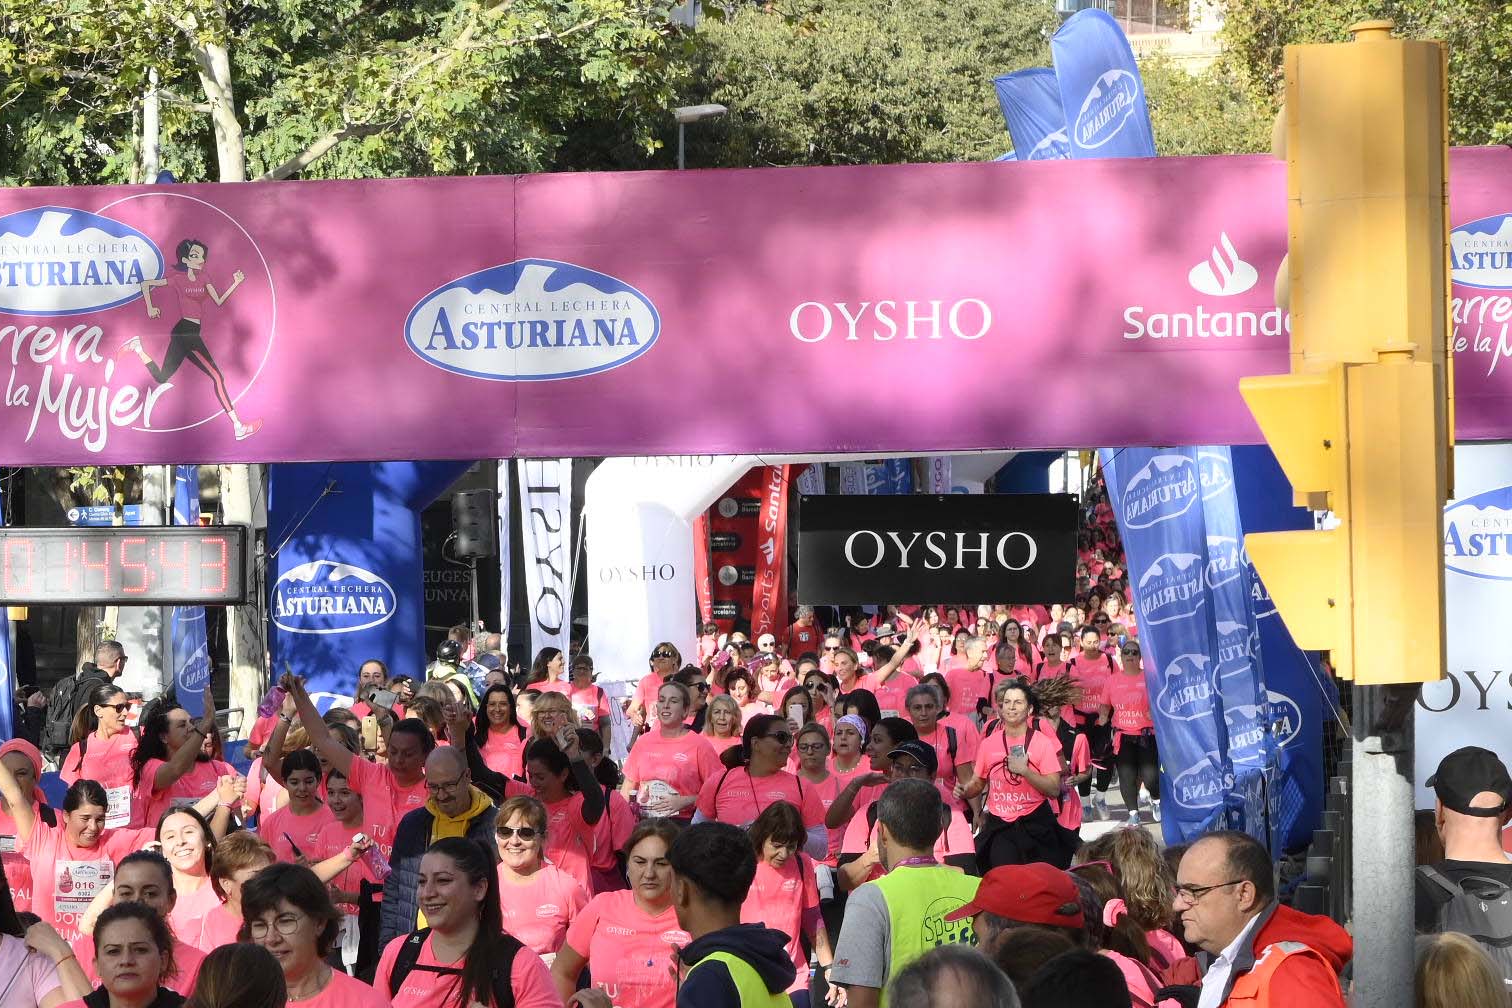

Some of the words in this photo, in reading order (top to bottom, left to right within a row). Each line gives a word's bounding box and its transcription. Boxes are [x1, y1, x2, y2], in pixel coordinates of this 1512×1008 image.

[65, 243, 139, 254] LECHERA
[1464, 239, 1512, 248] CENTRA
[464, 301, 542, 314] CENTRAL
[550, 300, 632, 313] LECHERA
[425, 306, 640, 351] ASTURIANA
[789, 298, 992, 342] OYSHO
[1123, 304, 1293, 340] Santand
[5, 367, 29, 407] la
[24, 358, 175, 453] Mujer
[844, 530, 1038, 571] OYSHO
[3, 538, 227, 593] 01:45:43
[599, 564, 675, 584] OYSHO
[286, 585, 332, 595] CENTRAL
[335, 584, 383, 593] LECHERA
[274, 589, 387, 618] ASTURIANA
[993, 793, 1031, 802] DORSAL
[372, 825, 386, 837] TU
[75, 881, 95, 889] 016
